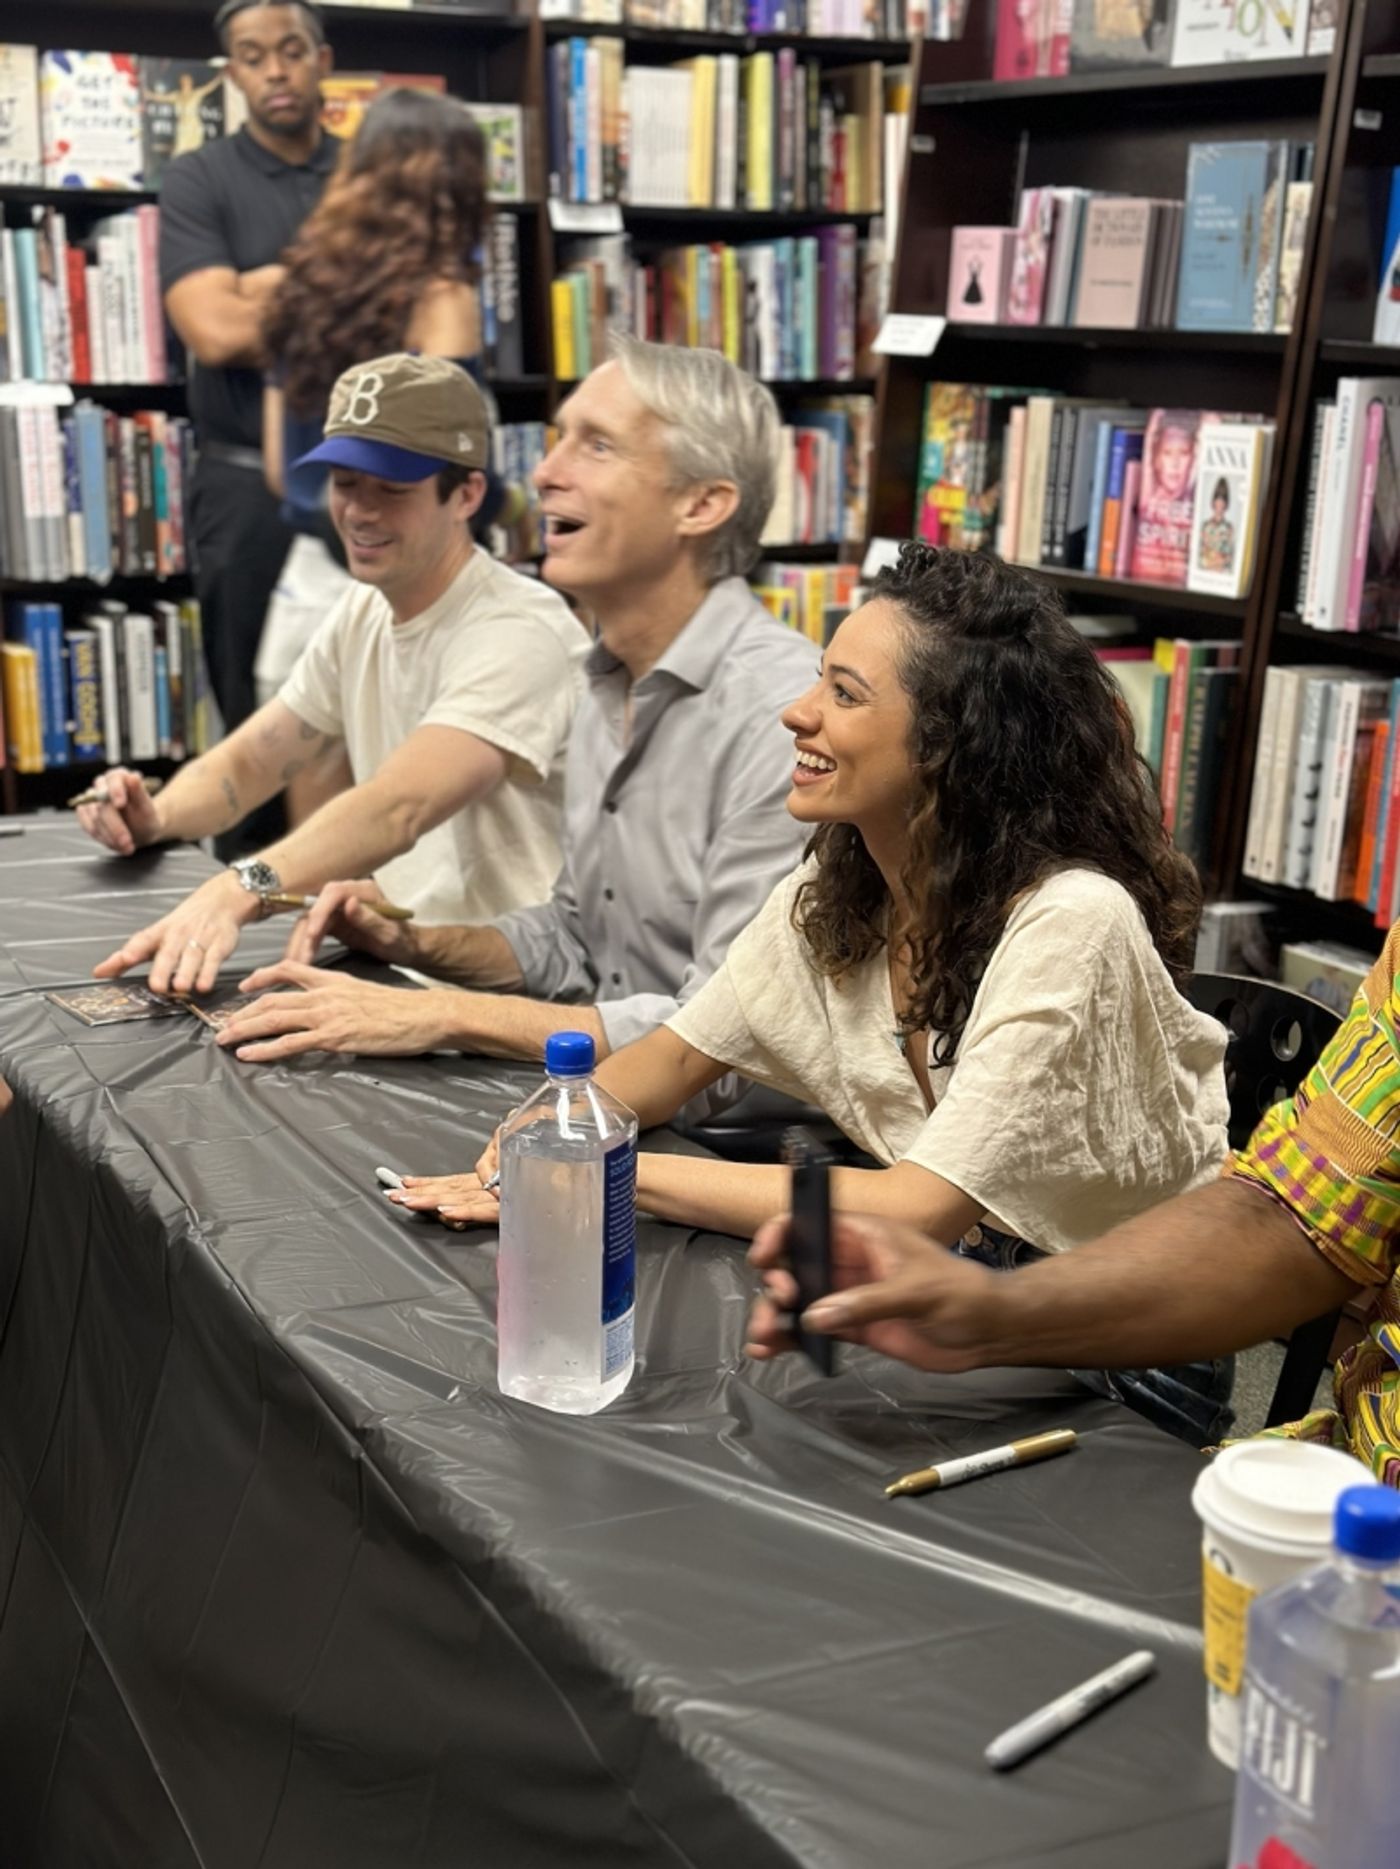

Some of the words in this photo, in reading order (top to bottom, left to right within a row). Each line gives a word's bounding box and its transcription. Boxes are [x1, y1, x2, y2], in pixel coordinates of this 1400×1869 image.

[341, 372, 385, 425] B
[1206, 446, 1248, 469] ANNA
[1245, 1686, 1318, 1807] FIJI
